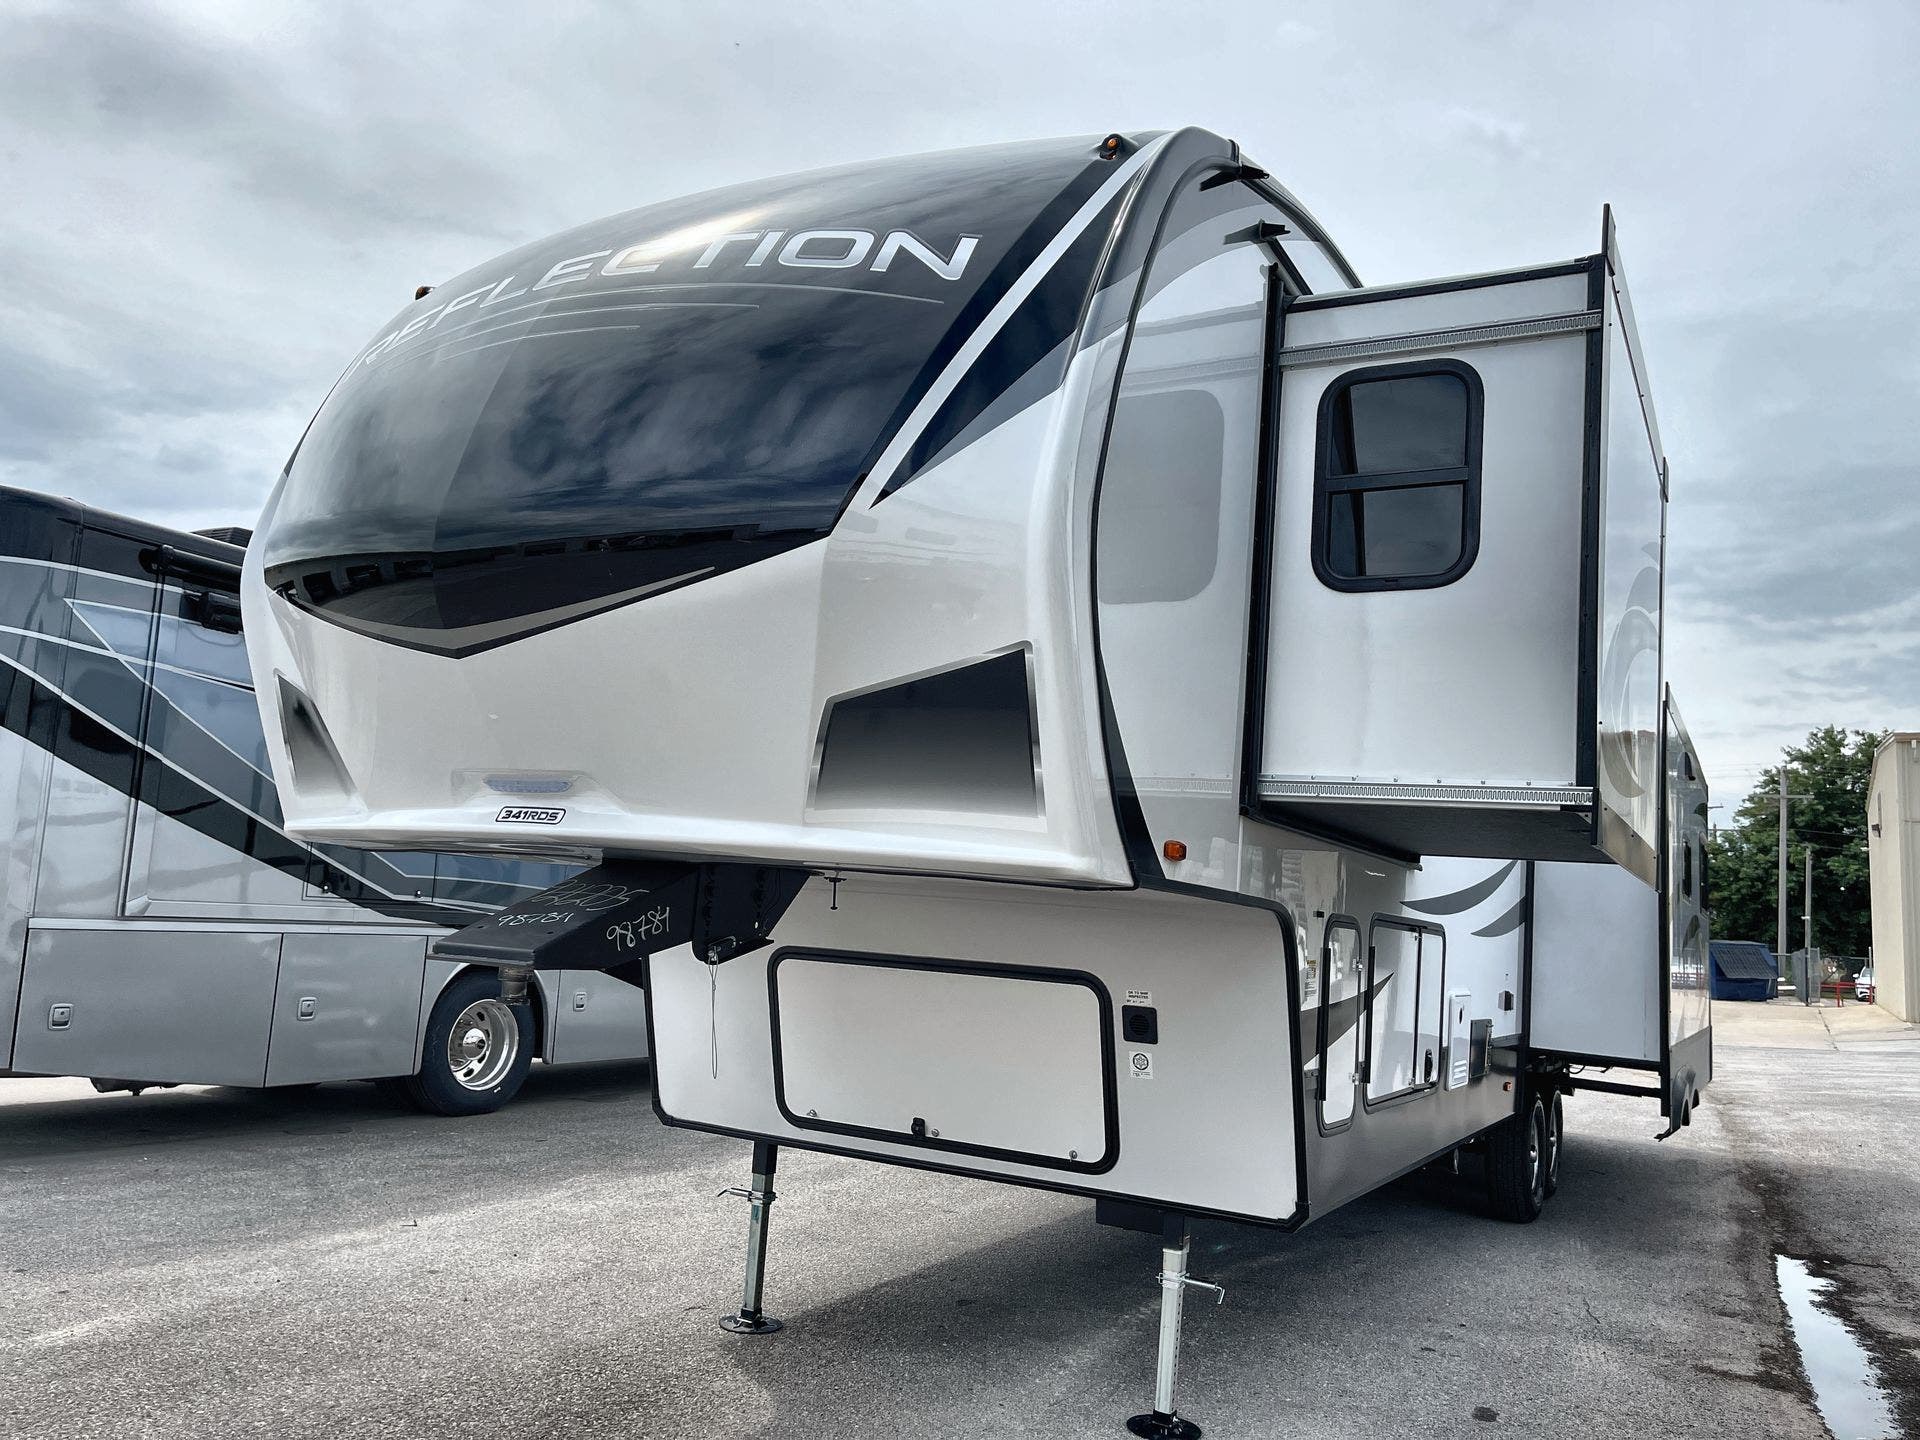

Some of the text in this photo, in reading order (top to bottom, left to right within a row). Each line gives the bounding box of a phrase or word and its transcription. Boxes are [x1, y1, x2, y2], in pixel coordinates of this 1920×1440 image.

[343, 228, 983, 383] REFLECTION
[501, 809, 560, 821] 341RDS
[606, 906, 670, 951] 98784
